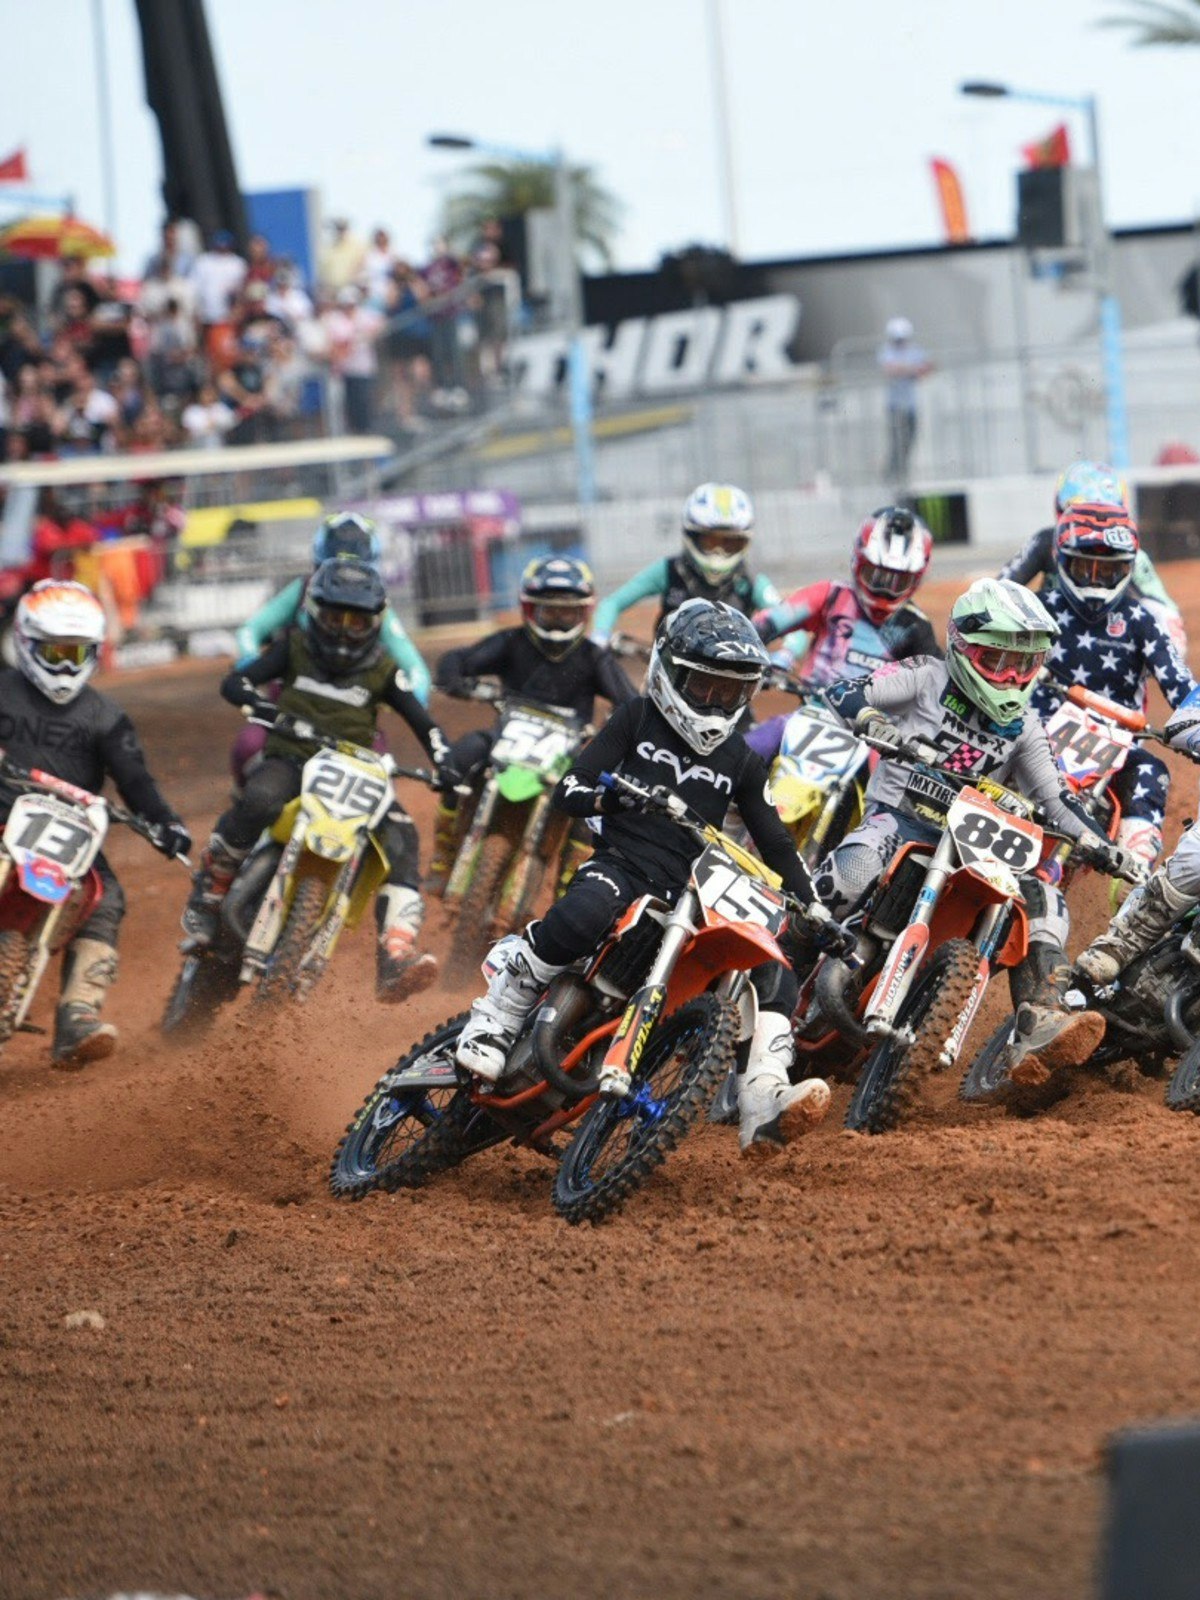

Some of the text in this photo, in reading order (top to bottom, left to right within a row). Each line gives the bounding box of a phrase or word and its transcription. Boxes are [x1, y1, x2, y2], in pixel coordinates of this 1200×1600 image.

[507, 292, 799, 398] THOR
[792, 723, 860, 769] 12
[1040, 719, 1123, 777] 444
[308, 764, 386, 813] 215
[14, 812, 93, 866] 13
[953, 812, 1034, 868] 88
[699, 864, 779, 926] 15
[629, 987, 664, 1074] DNLOP
